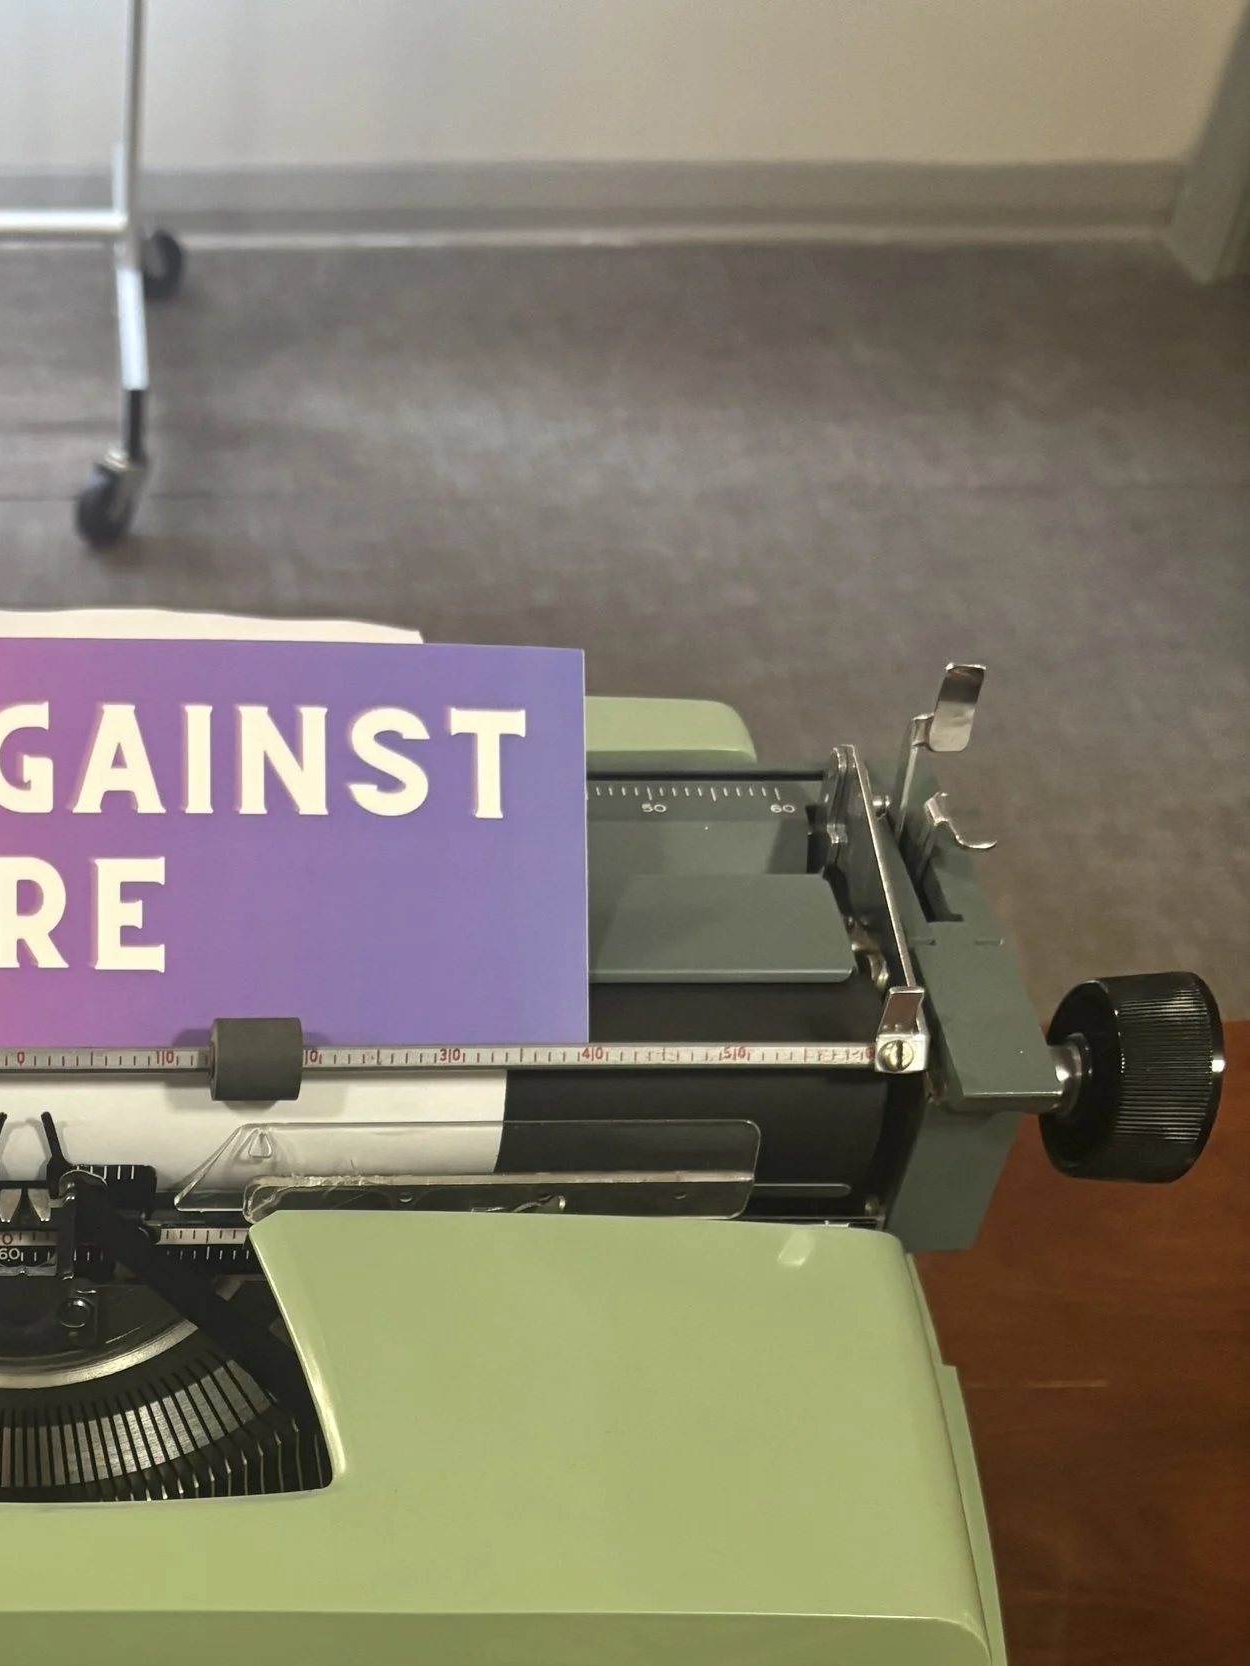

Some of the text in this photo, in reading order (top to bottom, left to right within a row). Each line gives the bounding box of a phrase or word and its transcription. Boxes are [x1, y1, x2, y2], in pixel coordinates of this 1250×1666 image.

[770, 804, 796, 814] 60
[439, 1047, 461, 1062] 30
[580, 1046, 604, 1061] 40
